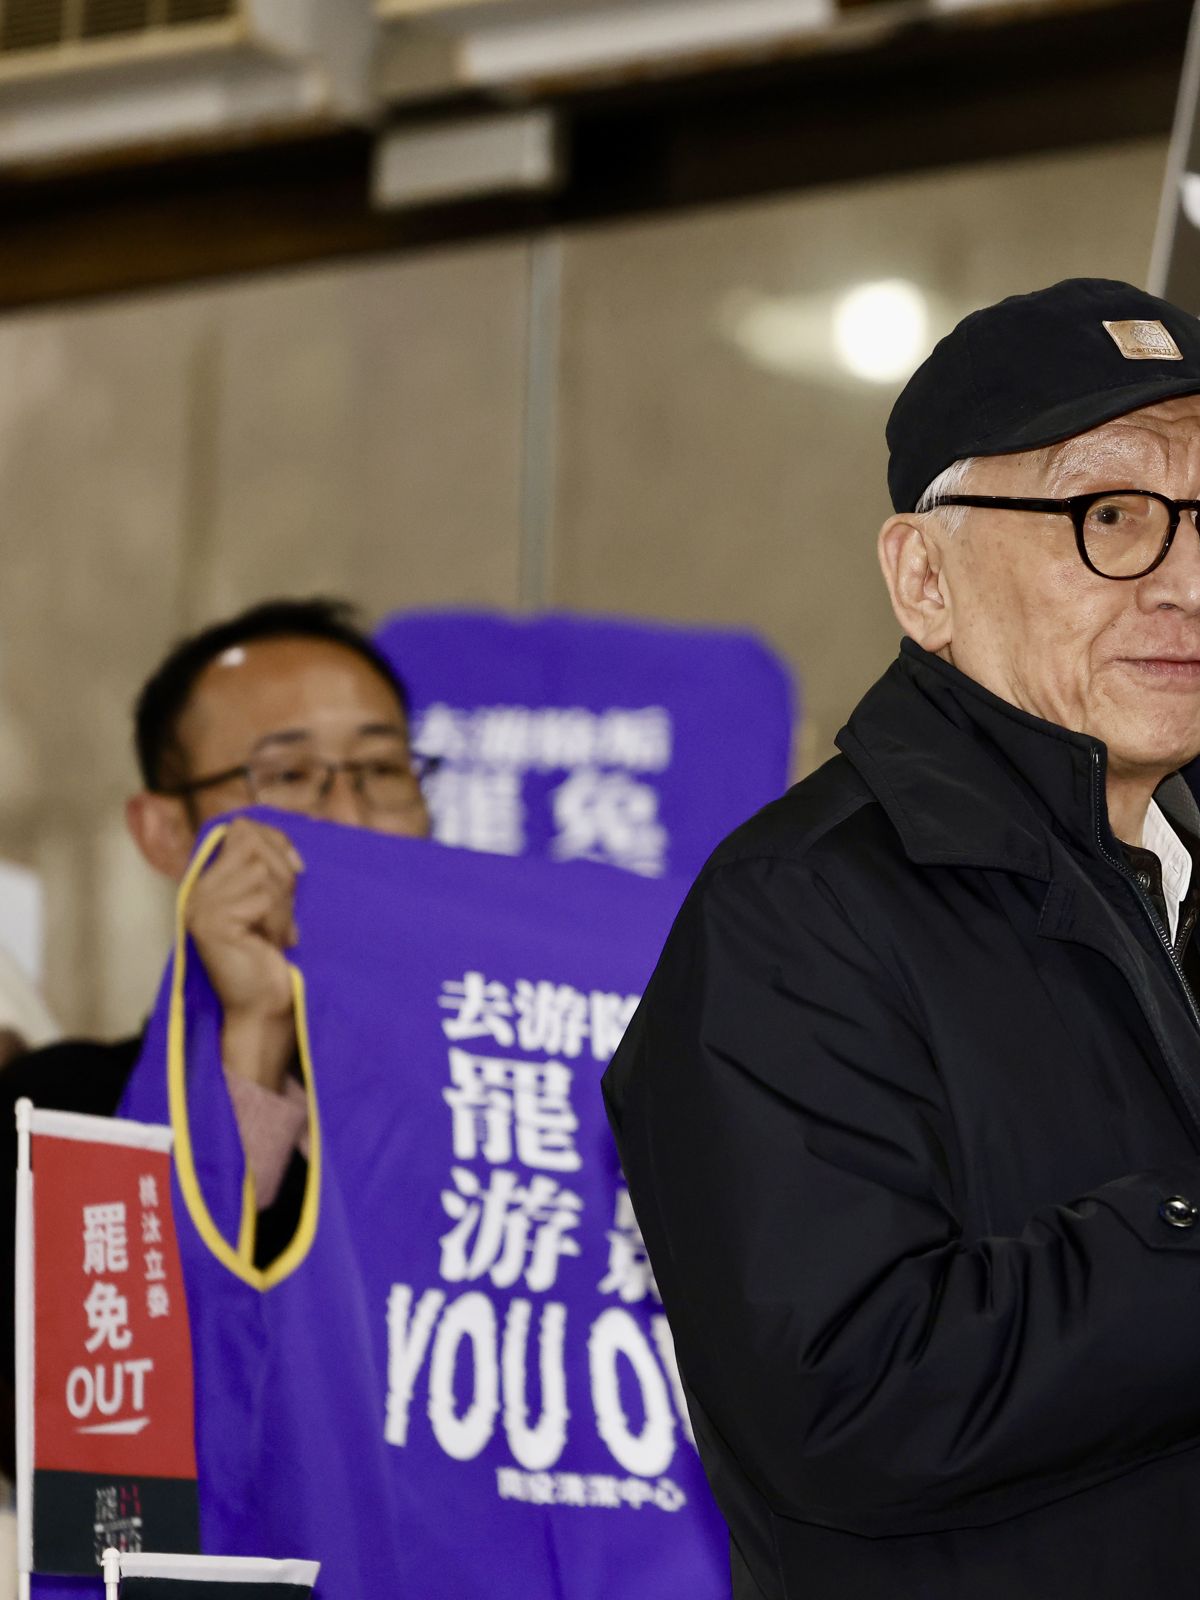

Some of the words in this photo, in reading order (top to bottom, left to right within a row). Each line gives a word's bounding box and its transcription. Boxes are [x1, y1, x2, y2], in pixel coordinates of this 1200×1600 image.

[82, 1202, 133, 1354] 罷免
[65, 1359, 154, 1420] OUT
[384, 1282, 570, 1471] YOU
